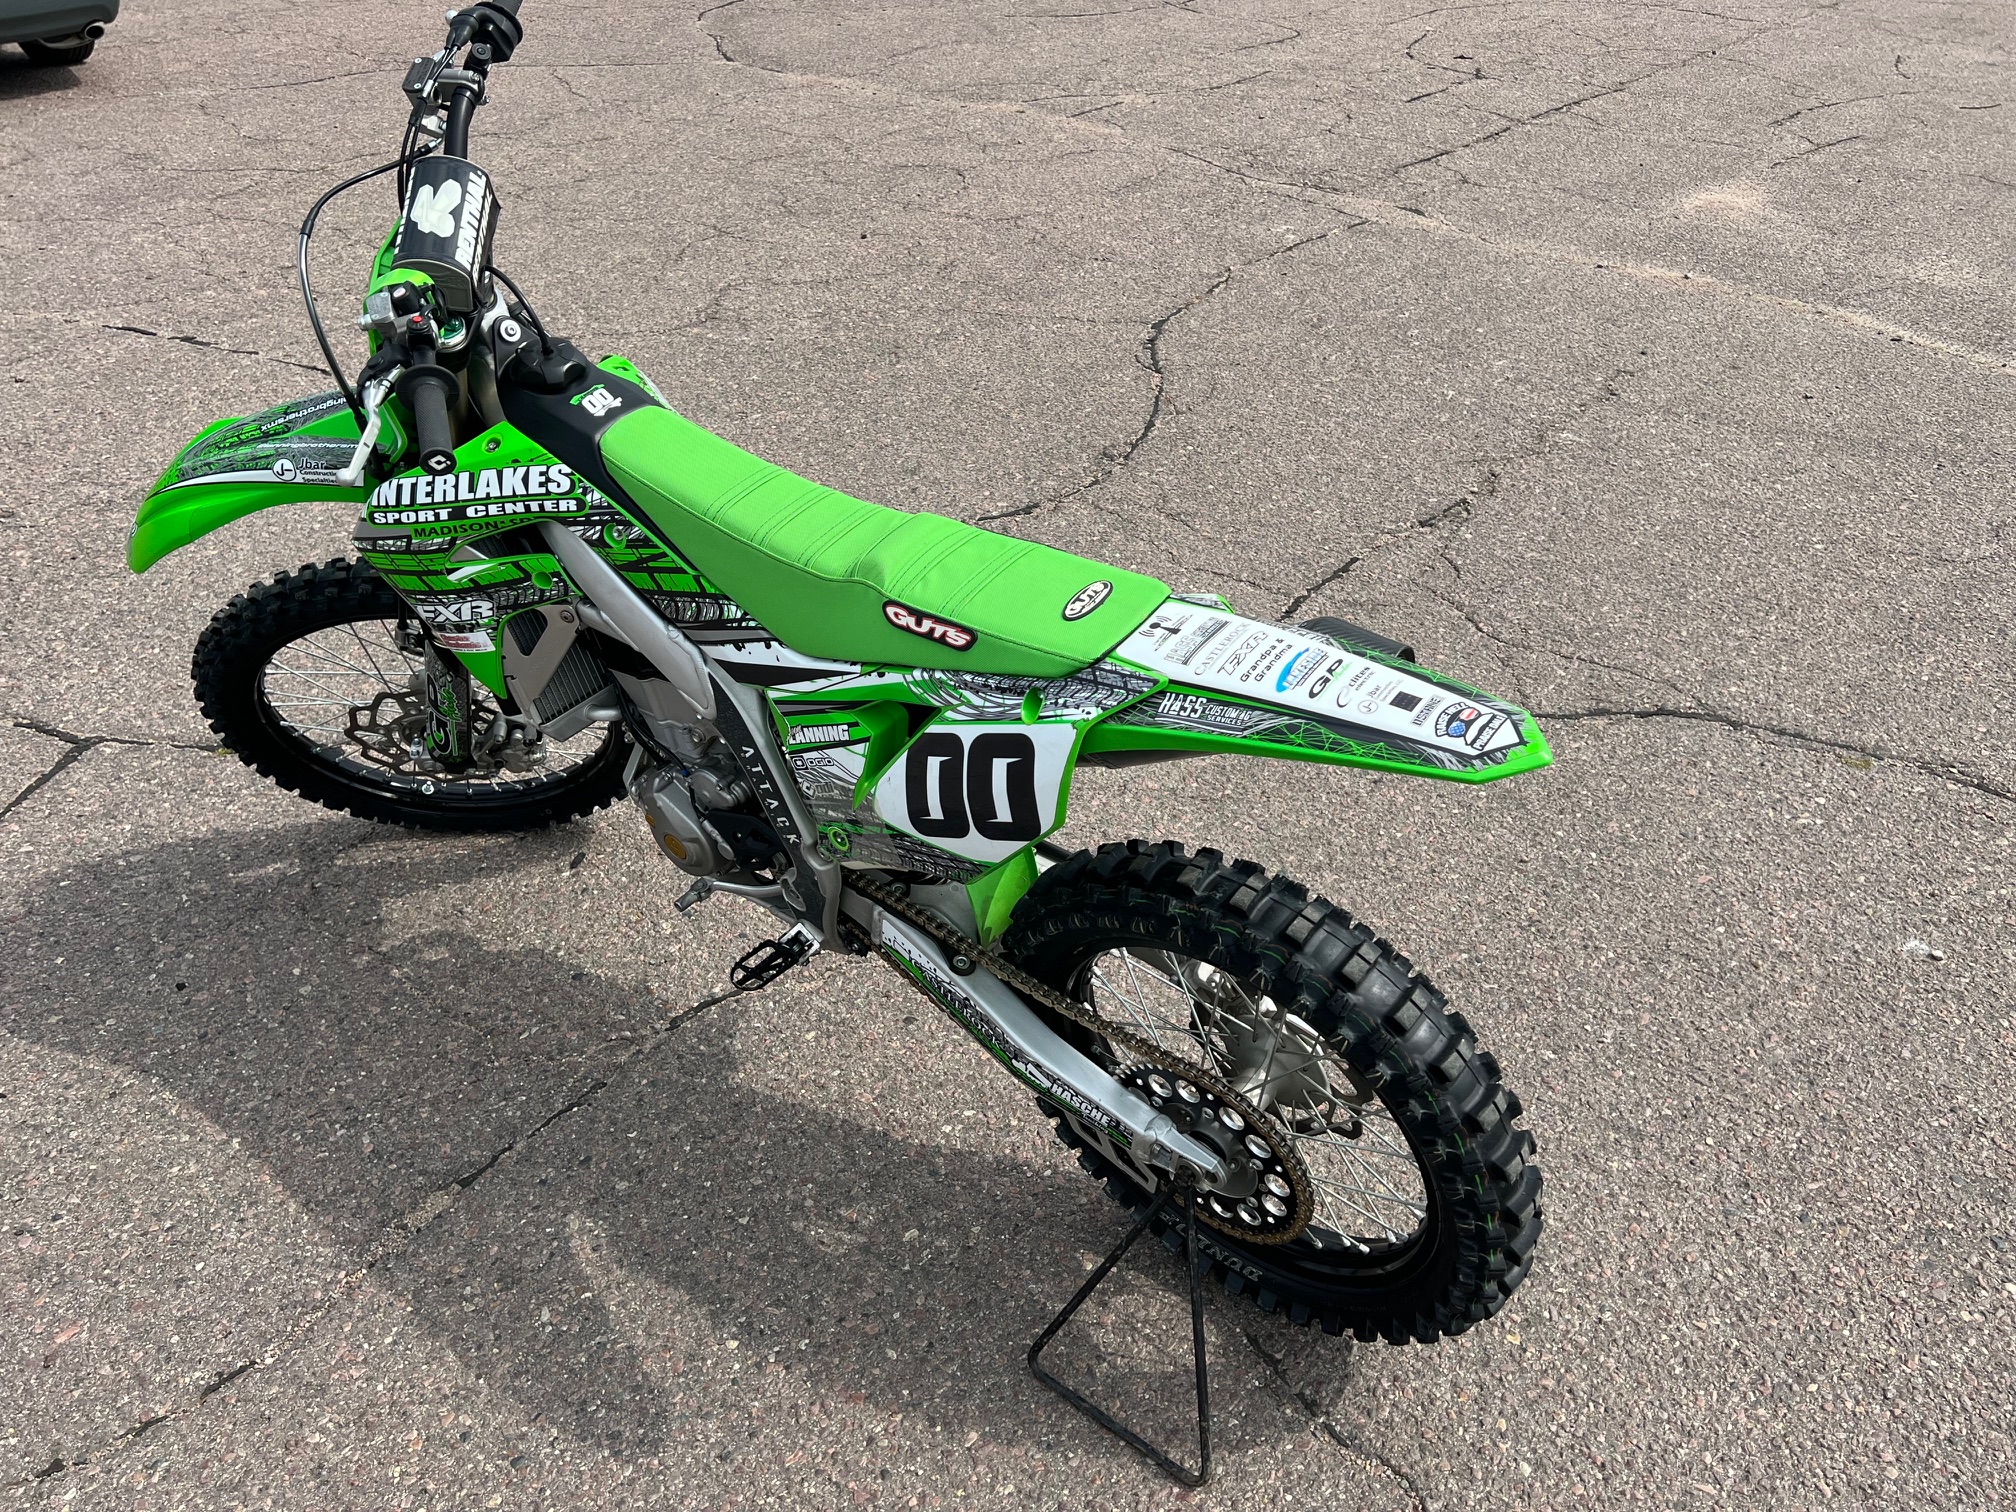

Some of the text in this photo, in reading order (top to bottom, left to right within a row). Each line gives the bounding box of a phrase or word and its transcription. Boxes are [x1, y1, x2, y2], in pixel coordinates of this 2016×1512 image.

[455, 171, 487, 271] RENTHAL
[582, 388, 615, 415] 00
[299, 458, 326, 470] Jbar
[371, 463, 573, 507] INTERLAKES
[374, 499, 578, 524] SPORT CENTER
[413, 520, 499, 539] MADISON
[416, 600, 496, 623] FXR
[885, 604, 973, 648] GUTS
[1194, 622, 1250, 676] CASTLEROCK
[1240, 643, 1278, 683] Grandpa
[1254, 643, 1293, 682] Grandma
[1348, 666, 1371, 687] clites
[1158, 692, 1207, 719] HASS
[1206, 704, 1239, 719] CUSTOM
[1207, 715, 1242, 726] SERVICES
[742, 745, 803, 845] ATTACK
[905, 732, 1042, 842] 00
[1051, 1083, 1111, 1127] HASCHE
